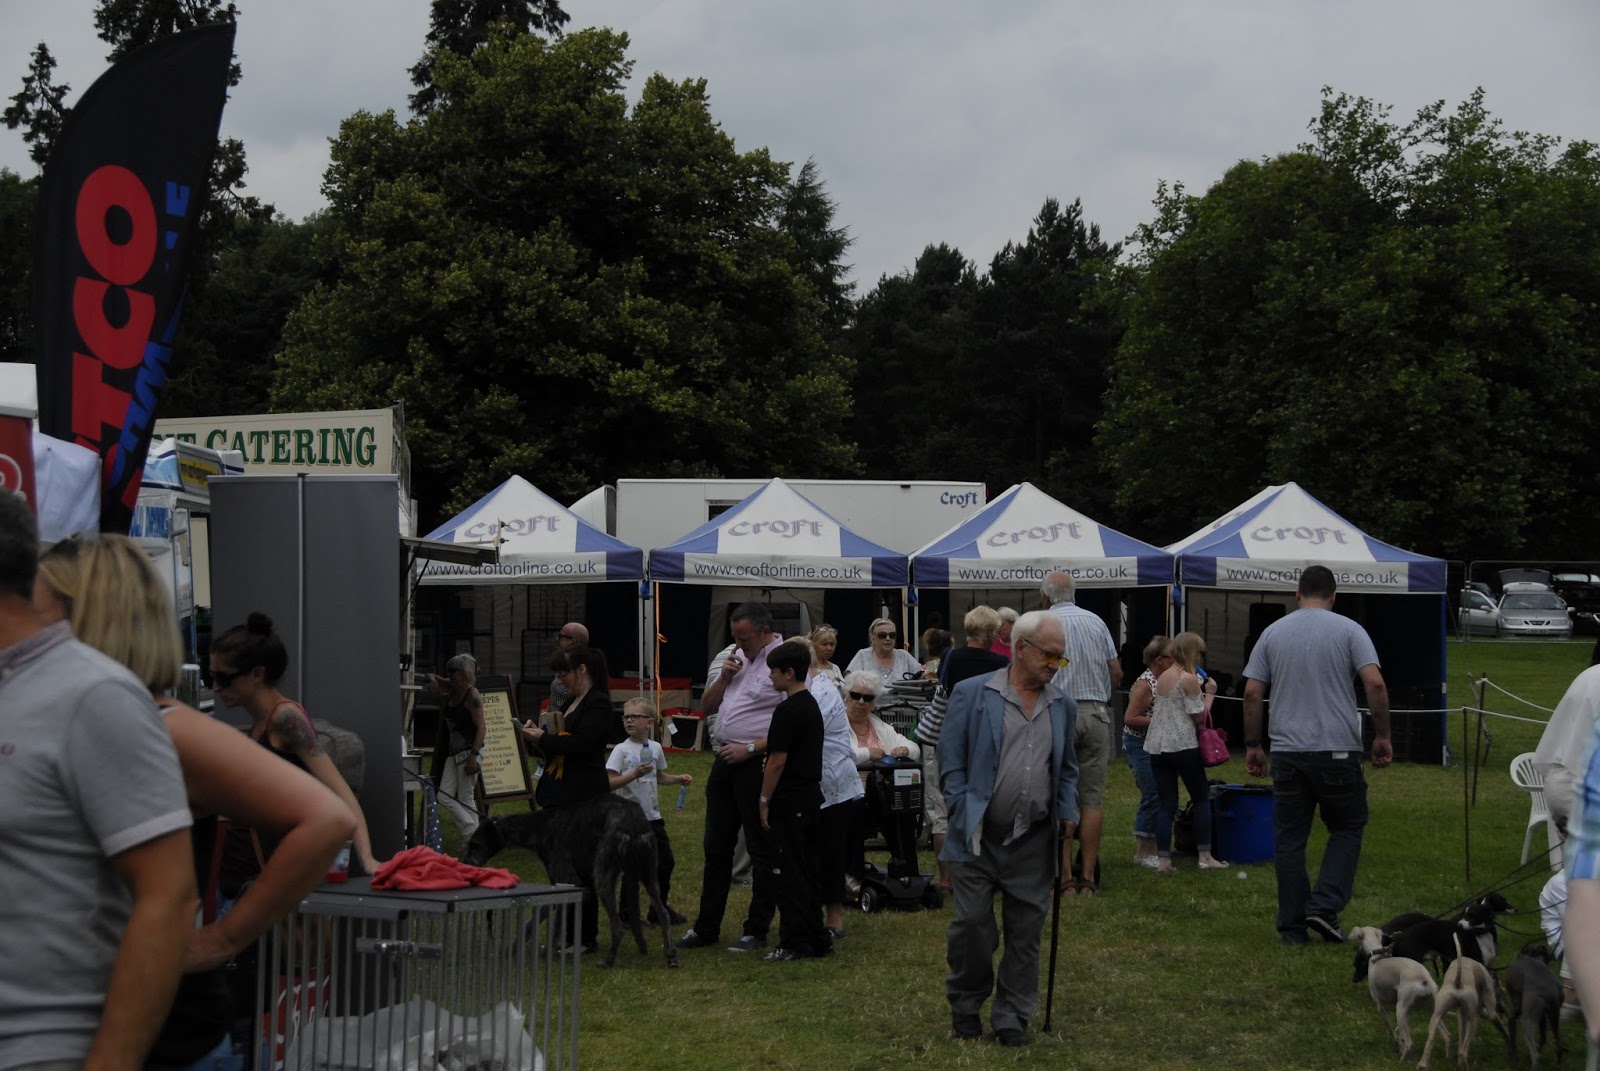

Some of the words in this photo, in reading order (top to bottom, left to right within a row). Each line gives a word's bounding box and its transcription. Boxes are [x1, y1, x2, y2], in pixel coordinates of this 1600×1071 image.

[206, 426, 377, 466] CATERING
[940, 491, 978, 509] Croft
[427, 560, 597, 576] www.croftonline.co.uk
[694, 562, 862, 579] www.croftonline.co.uk
[1226, 567, 1398, 584] www.croftne.co.uk
